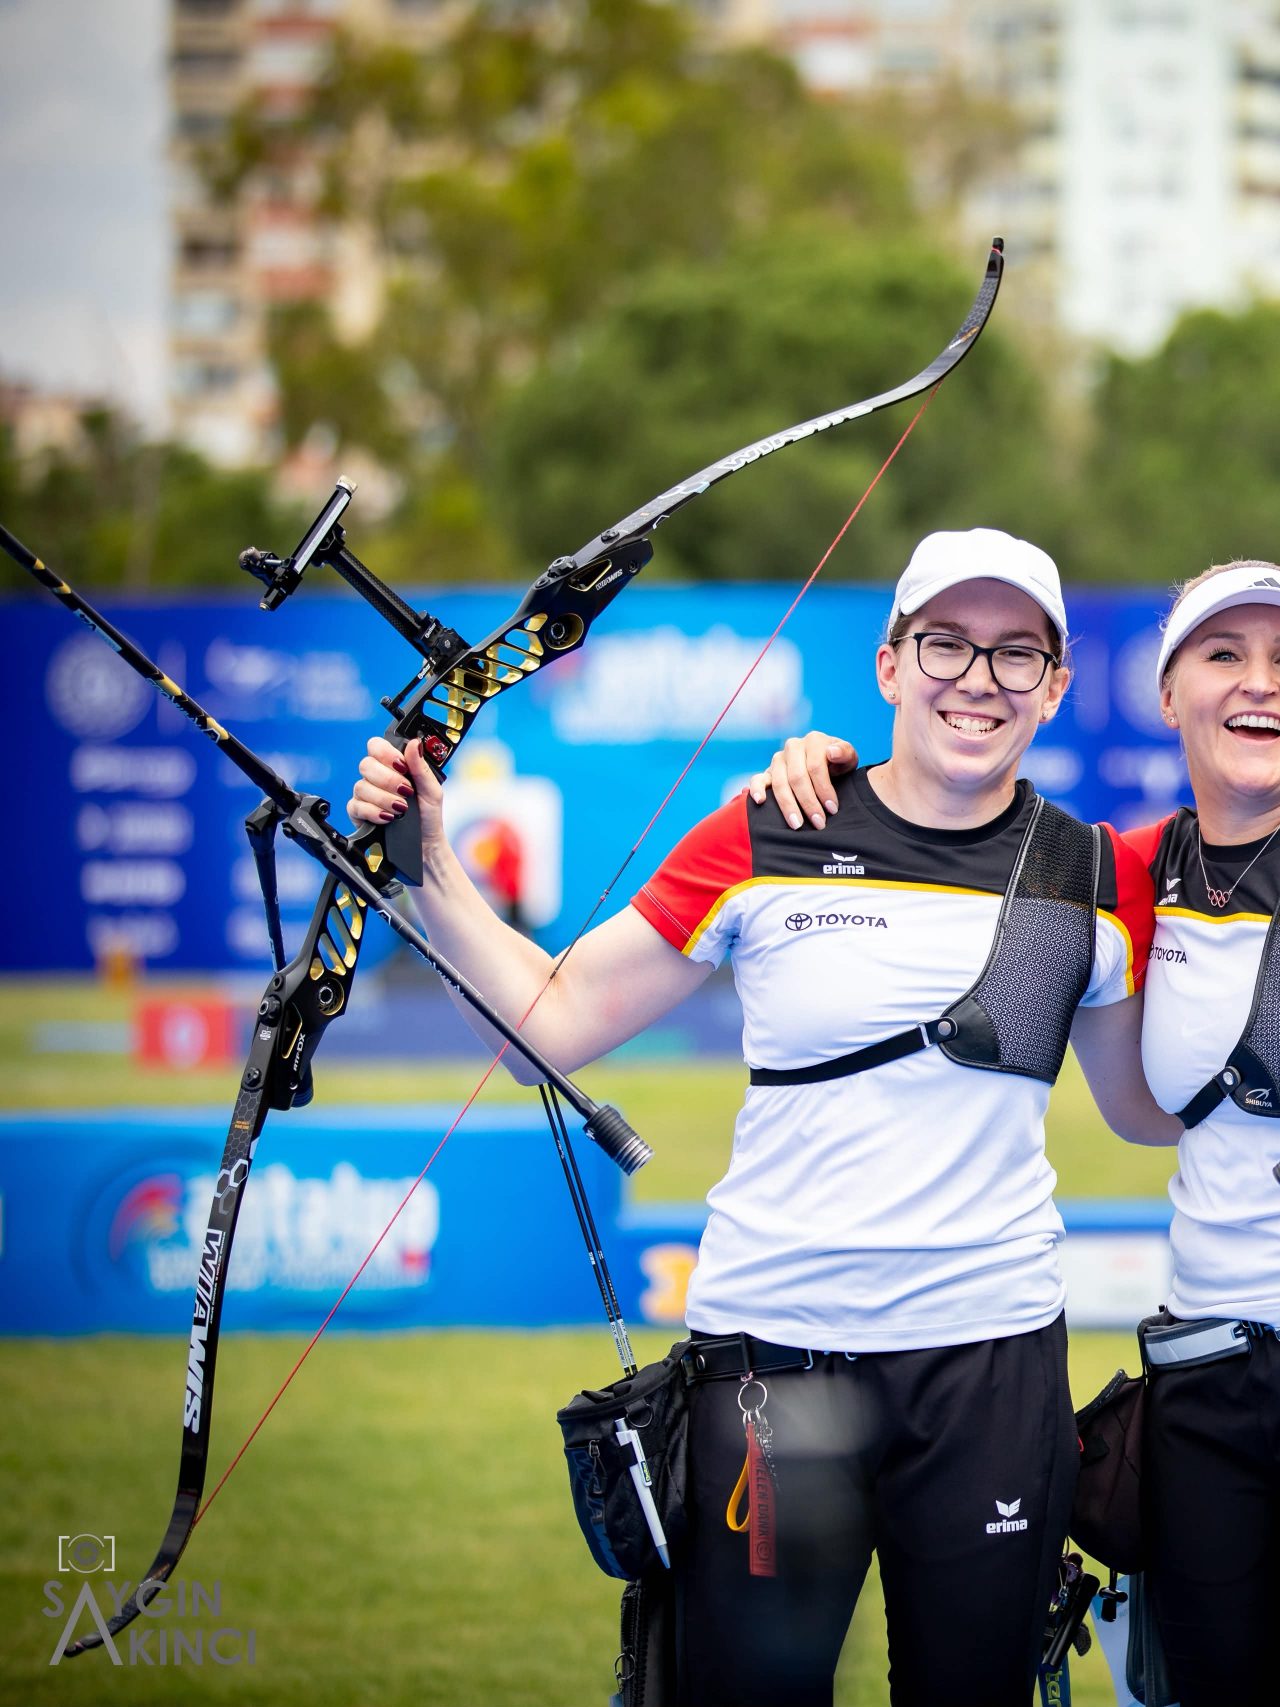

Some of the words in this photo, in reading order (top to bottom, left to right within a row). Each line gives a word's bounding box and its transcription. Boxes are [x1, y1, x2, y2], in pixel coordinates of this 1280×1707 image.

[823, 862, 864, 874] erima
[815, 914, 888, 928] TOYOTA
[1154, 946, 1188, 964] TOYOTA
[1245, 1097, 1272, 1108] SHIBUYA
[184, 1228, 222, 1434] WIAWIS
[758, 1504, 770, 1536] DANK
[986, 1519, 1028, 1534] erima
